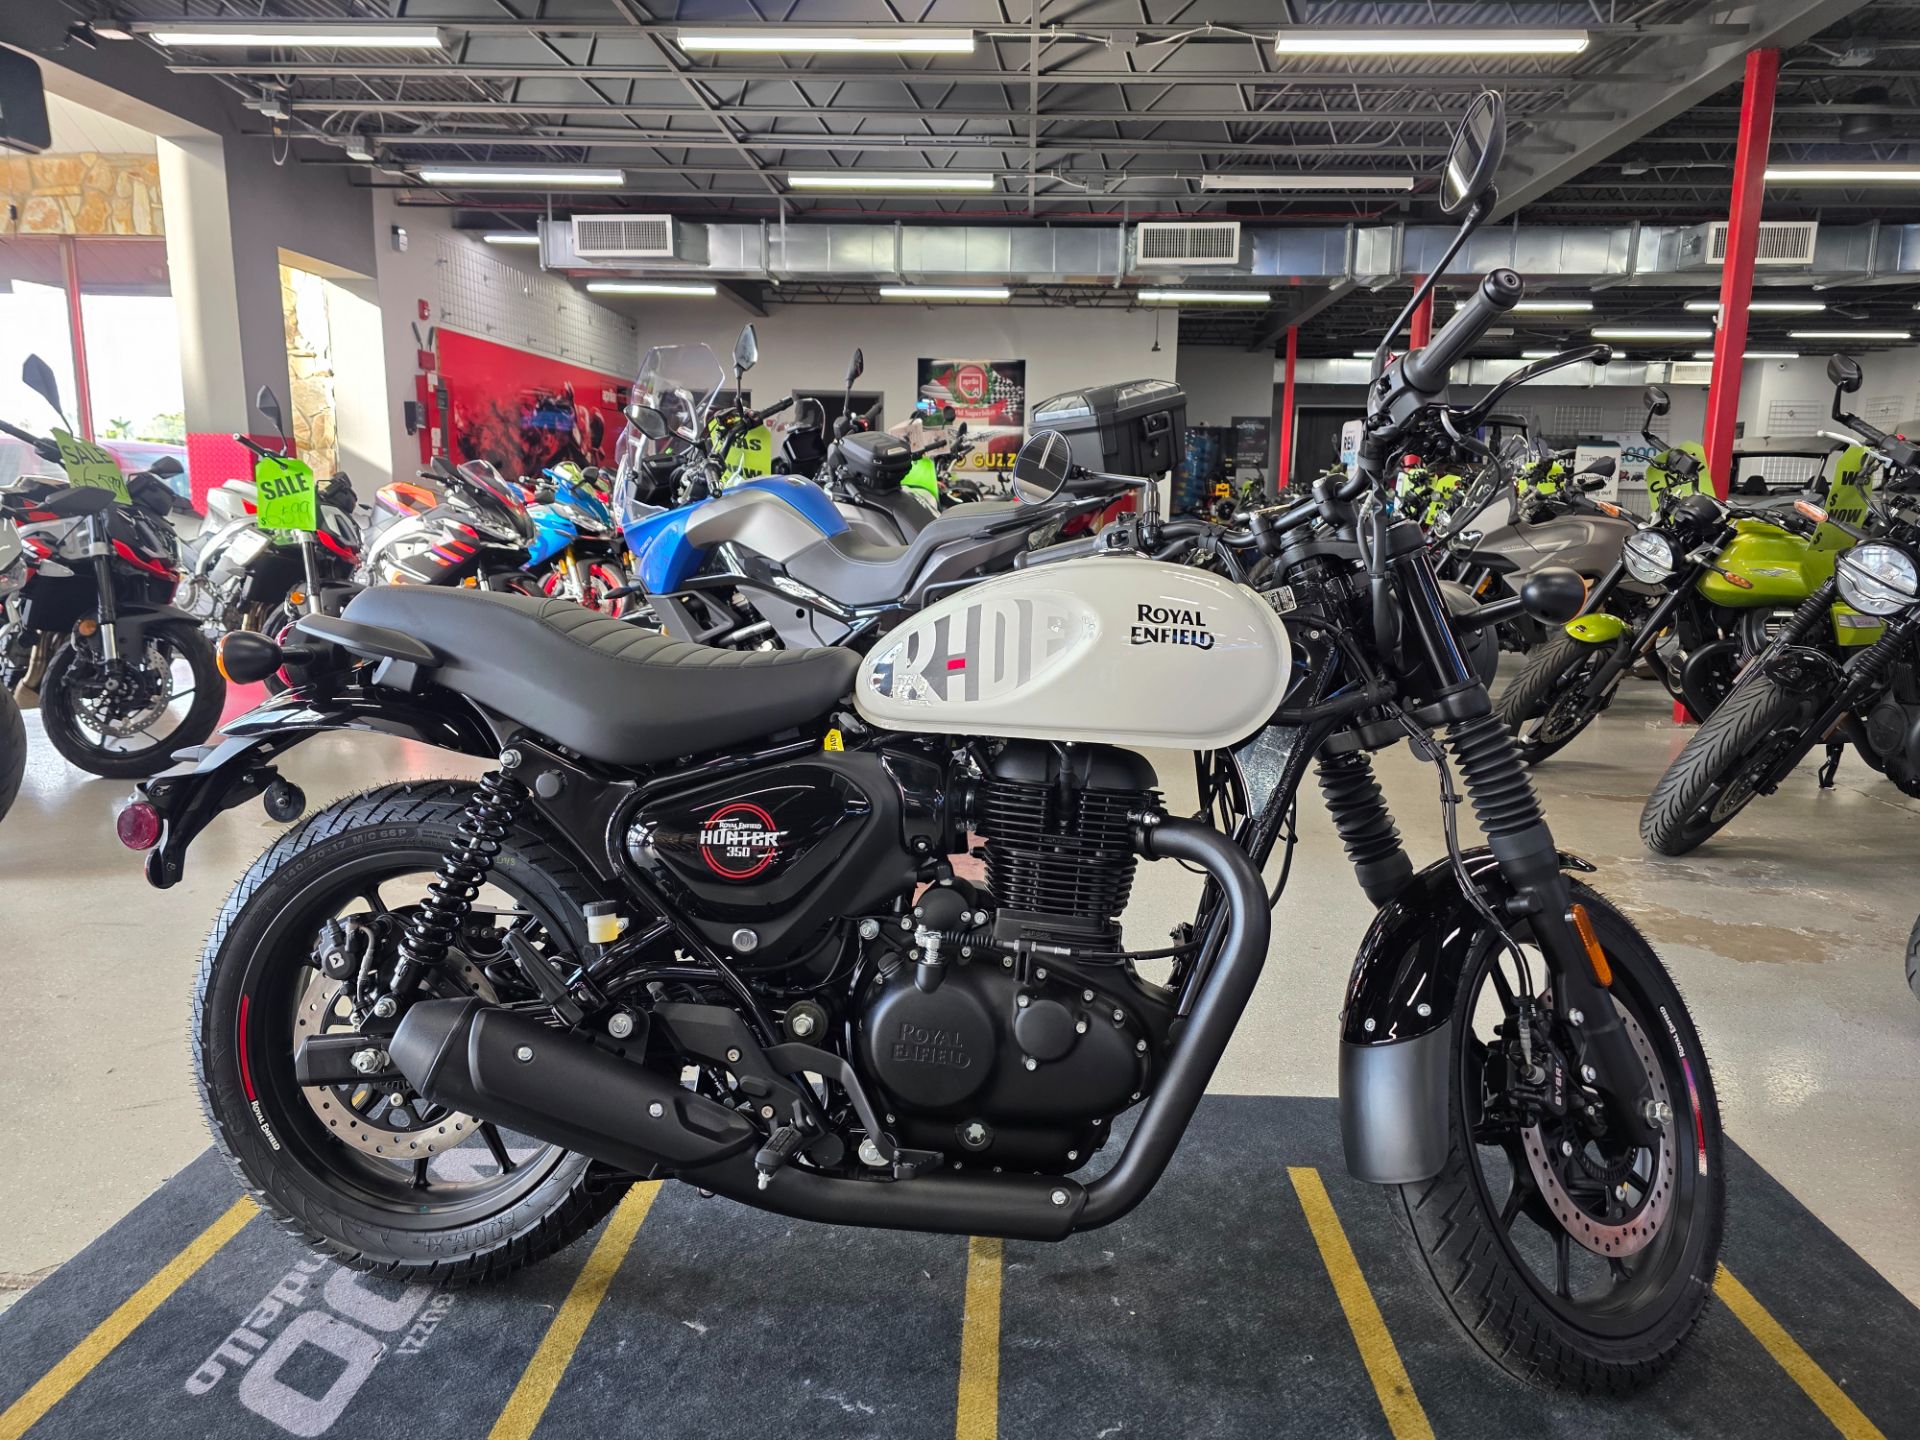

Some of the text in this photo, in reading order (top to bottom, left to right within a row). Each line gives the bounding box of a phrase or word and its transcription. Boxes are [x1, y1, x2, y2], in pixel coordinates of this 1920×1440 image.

[61, 445, 115, 465] SALE
[973, 453, 1018, 468] GUZZ
[260, 472, 310, 500] SALE
[1841, 471, 1871, 486] WS
[1829, 508, 1863, 523] NOW
[1137, 603, 1206, 626] ROYAL
[1130, 626, 1215, 650] ENFIELD
[719, 822, 763, 830] ROYAL ENFIELD
[726, 846, 751, 857] 350
[900, 1022, 963, 1048] ROYAL
[1660, 1006, 1686, 1058] ROYAL ENFIELD
[892, 1043, 972, 1070] ENFIELD
[1554, 1061, 1563, 1106] BYBR
[251, 1100, 281, 1151] ROYAL ENFIELD
